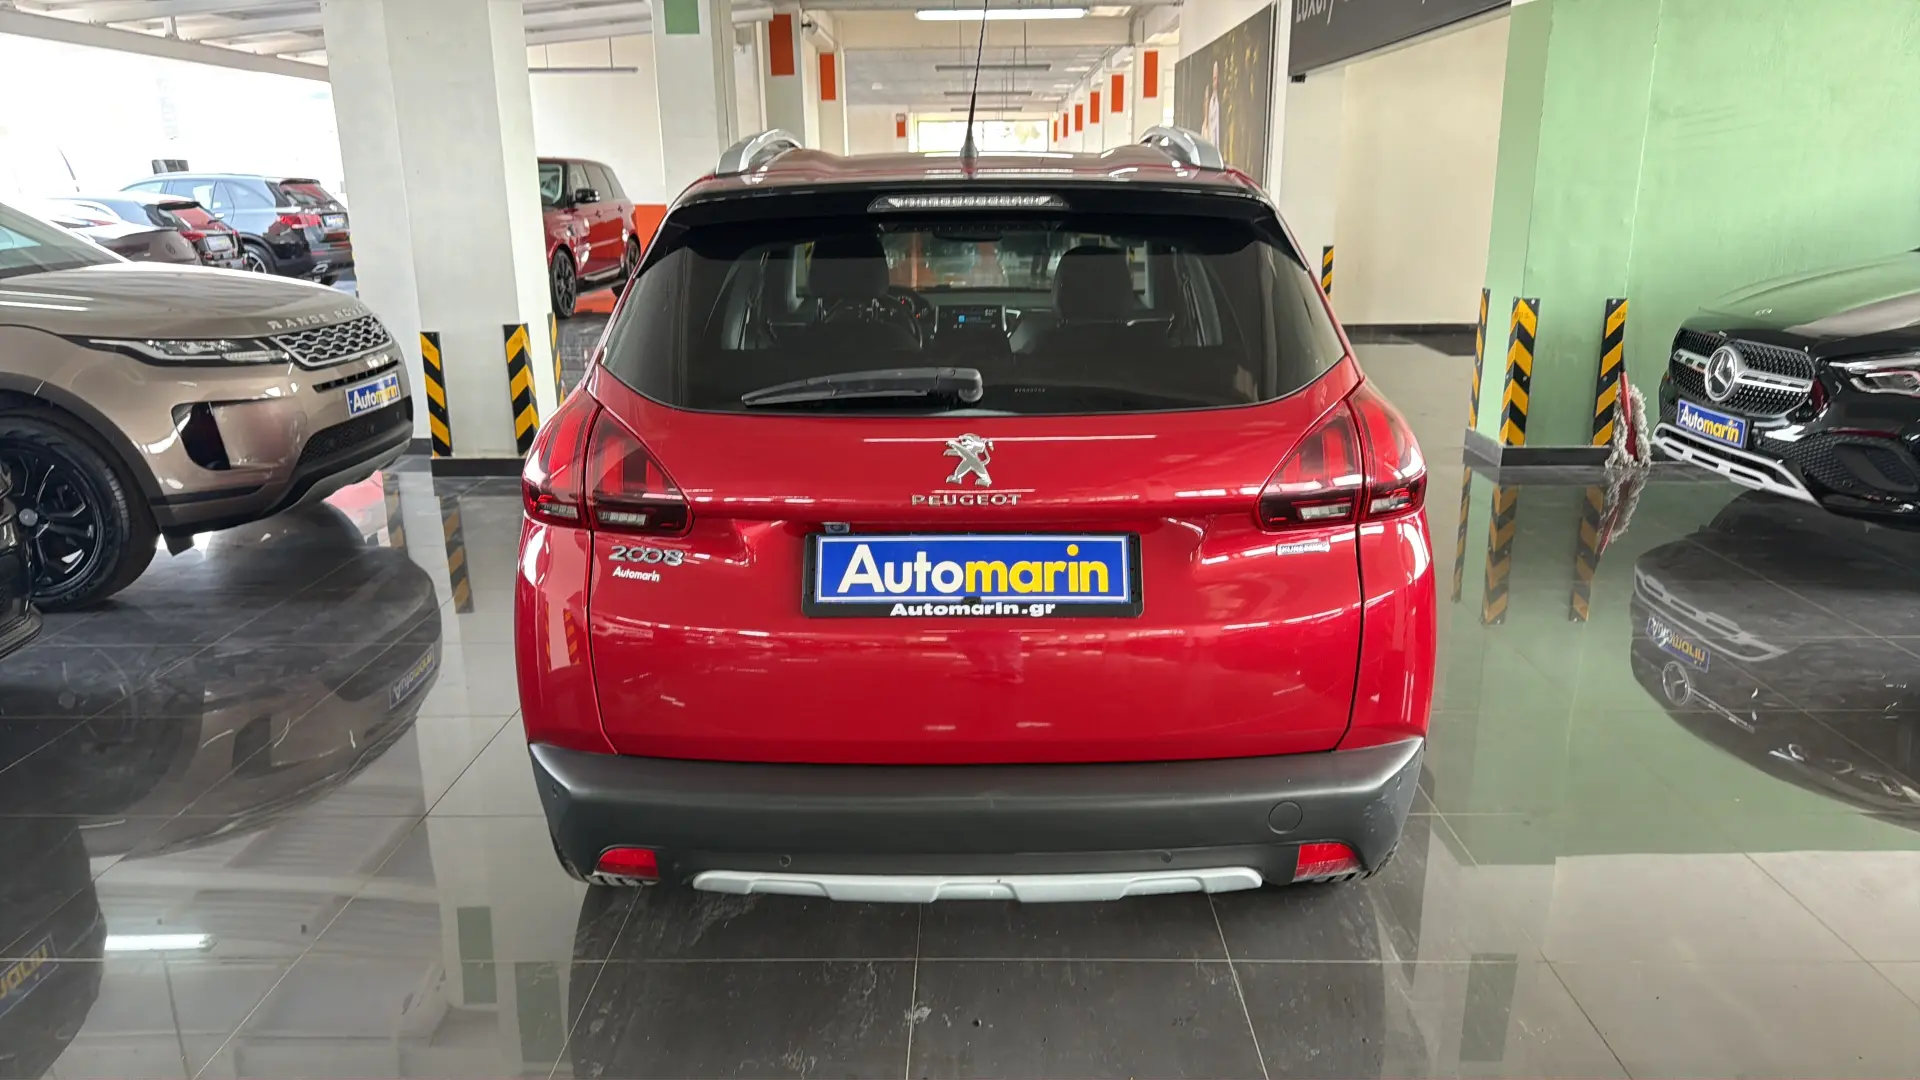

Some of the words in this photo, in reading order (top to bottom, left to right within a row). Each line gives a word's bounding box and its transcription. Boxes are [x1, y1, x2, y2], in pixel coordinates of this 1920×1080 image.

[267, 314, 328, 331] RANGE
[334, 304, 366, 320] ROV
[1680, 403, 1740, 443] Automarin
[911, 493, 1022, 507] PEUGEOT
[608, 545, 684, 567] 2008
[612, 565, 661, 583] Automarin
[836, 544, 1110, 594] Automarin
[889, 601, 1057, 618] Automarin.gr
